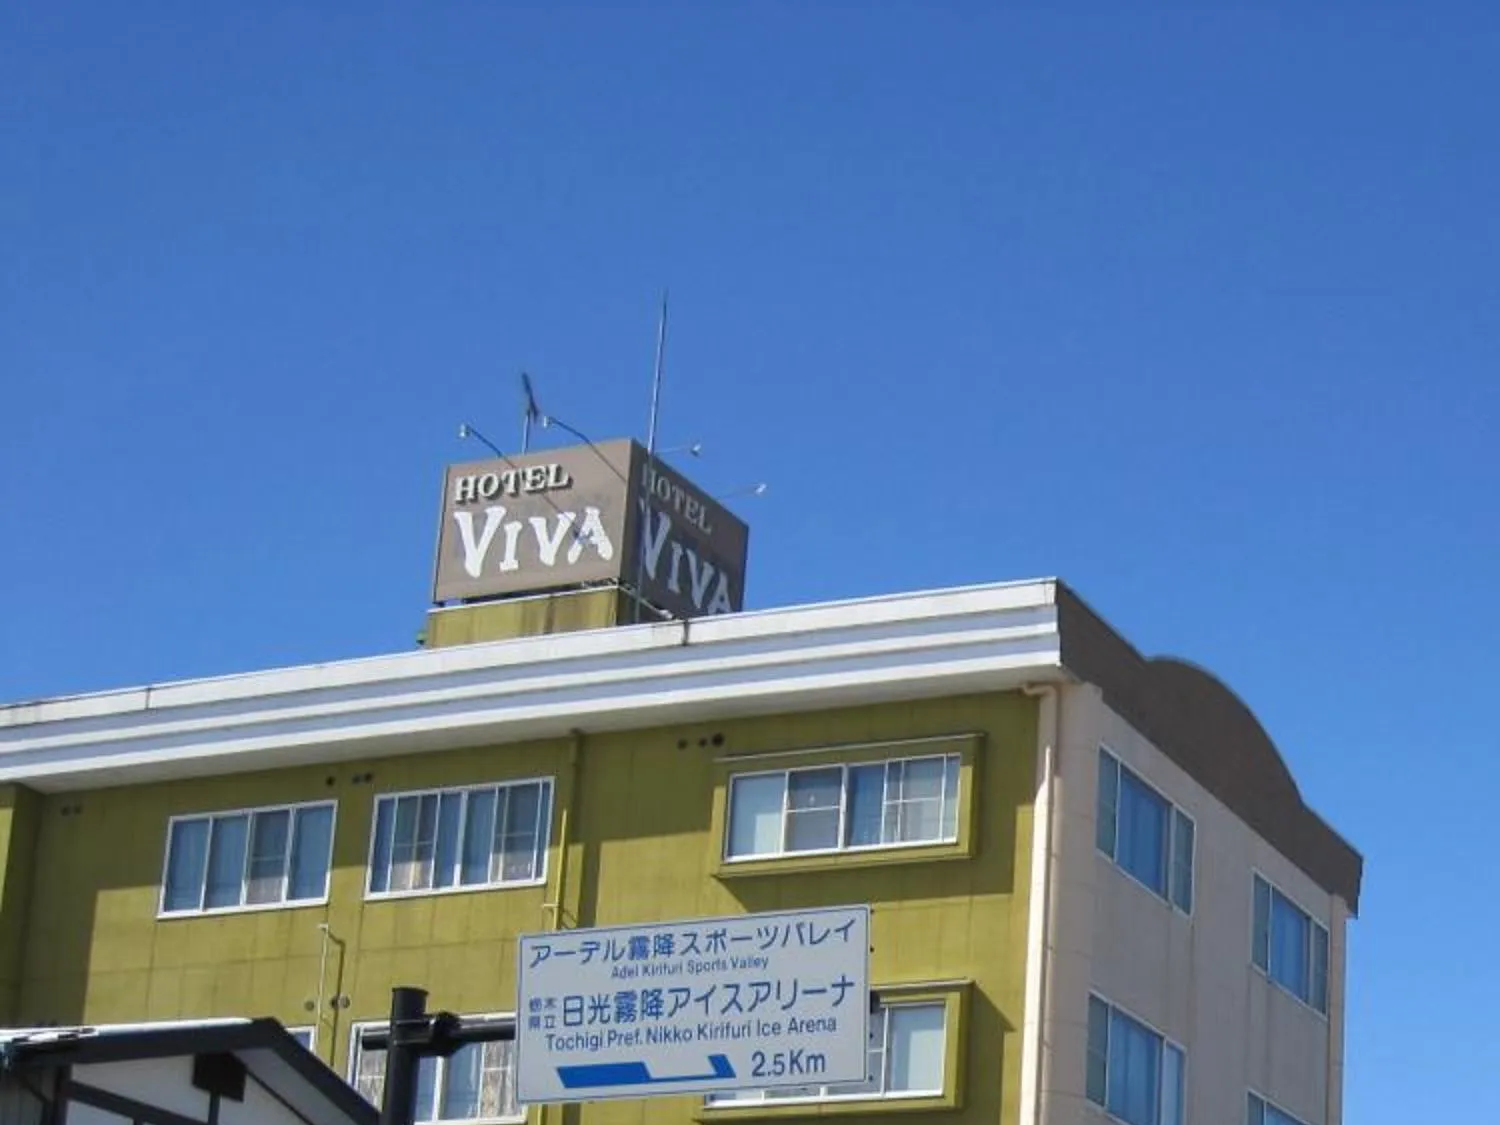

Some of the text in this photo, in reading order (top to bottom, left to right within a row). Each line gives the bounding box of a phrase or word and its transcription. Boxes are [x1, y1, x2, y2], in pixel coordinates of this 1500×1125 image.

[455, 464, 571, 500] HOTEL
[642, 463, 712, 534] HOTEL
[454, 505, 614, 578] VIVA
[640, 498, 732, 615] VIVA
[529, 918, 856, 968] アーデル霧降スポーツバレイ
[642, 961, 683, 977] Kirifuri
[687, 959, 728, 975] Sports
[730, 956, 769, 971] Valley
[562, 974, 855, 1027] 日光霧降アイスアリーナ
[545, 1016, 837, 1052] Tochigi Pref. Nikko Kirifuri Ice Arena
